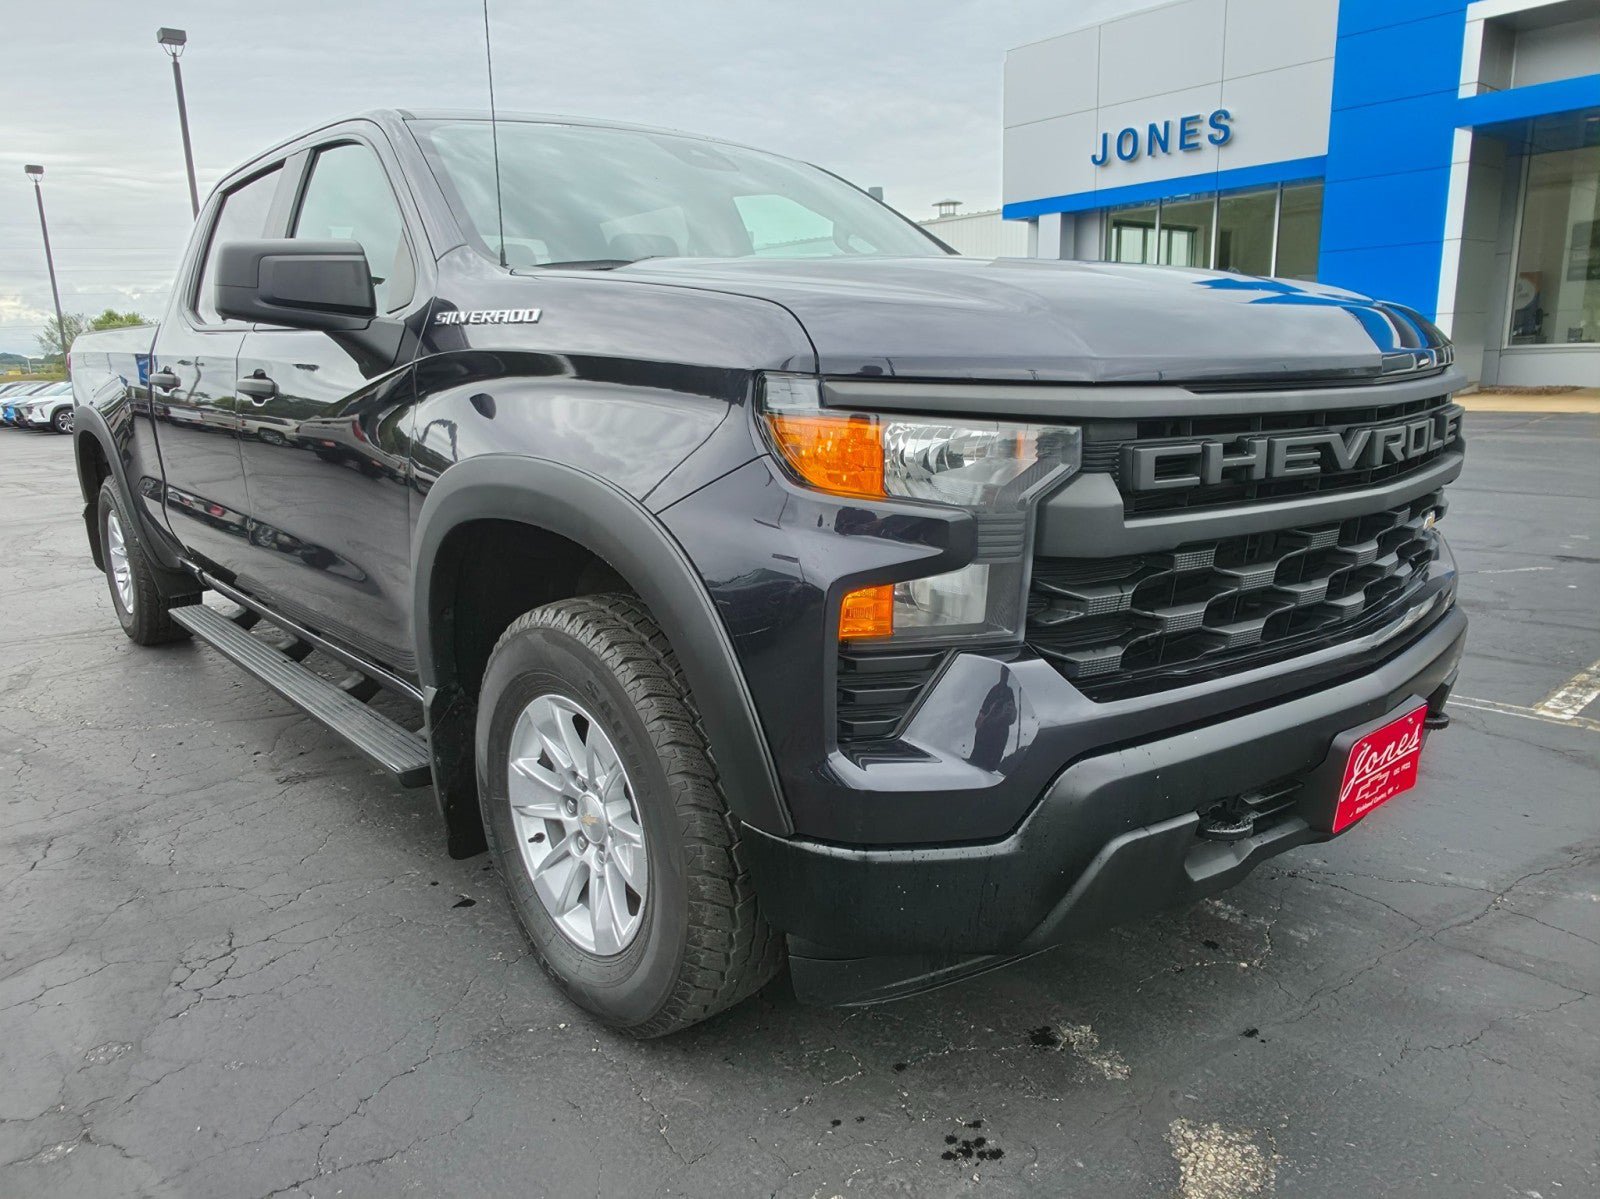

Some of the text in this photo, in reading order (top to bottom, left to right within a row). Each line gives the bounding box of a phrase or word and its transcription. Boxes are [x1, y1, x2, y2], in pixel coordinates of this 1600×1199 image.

[1091, 108, 1234, 167] JONES
[434, 308, 542, 326] SILVERADO
[1132, 406, 1465, 491] CHEVROLE
[1340, 723, 1421, 803] Jones
